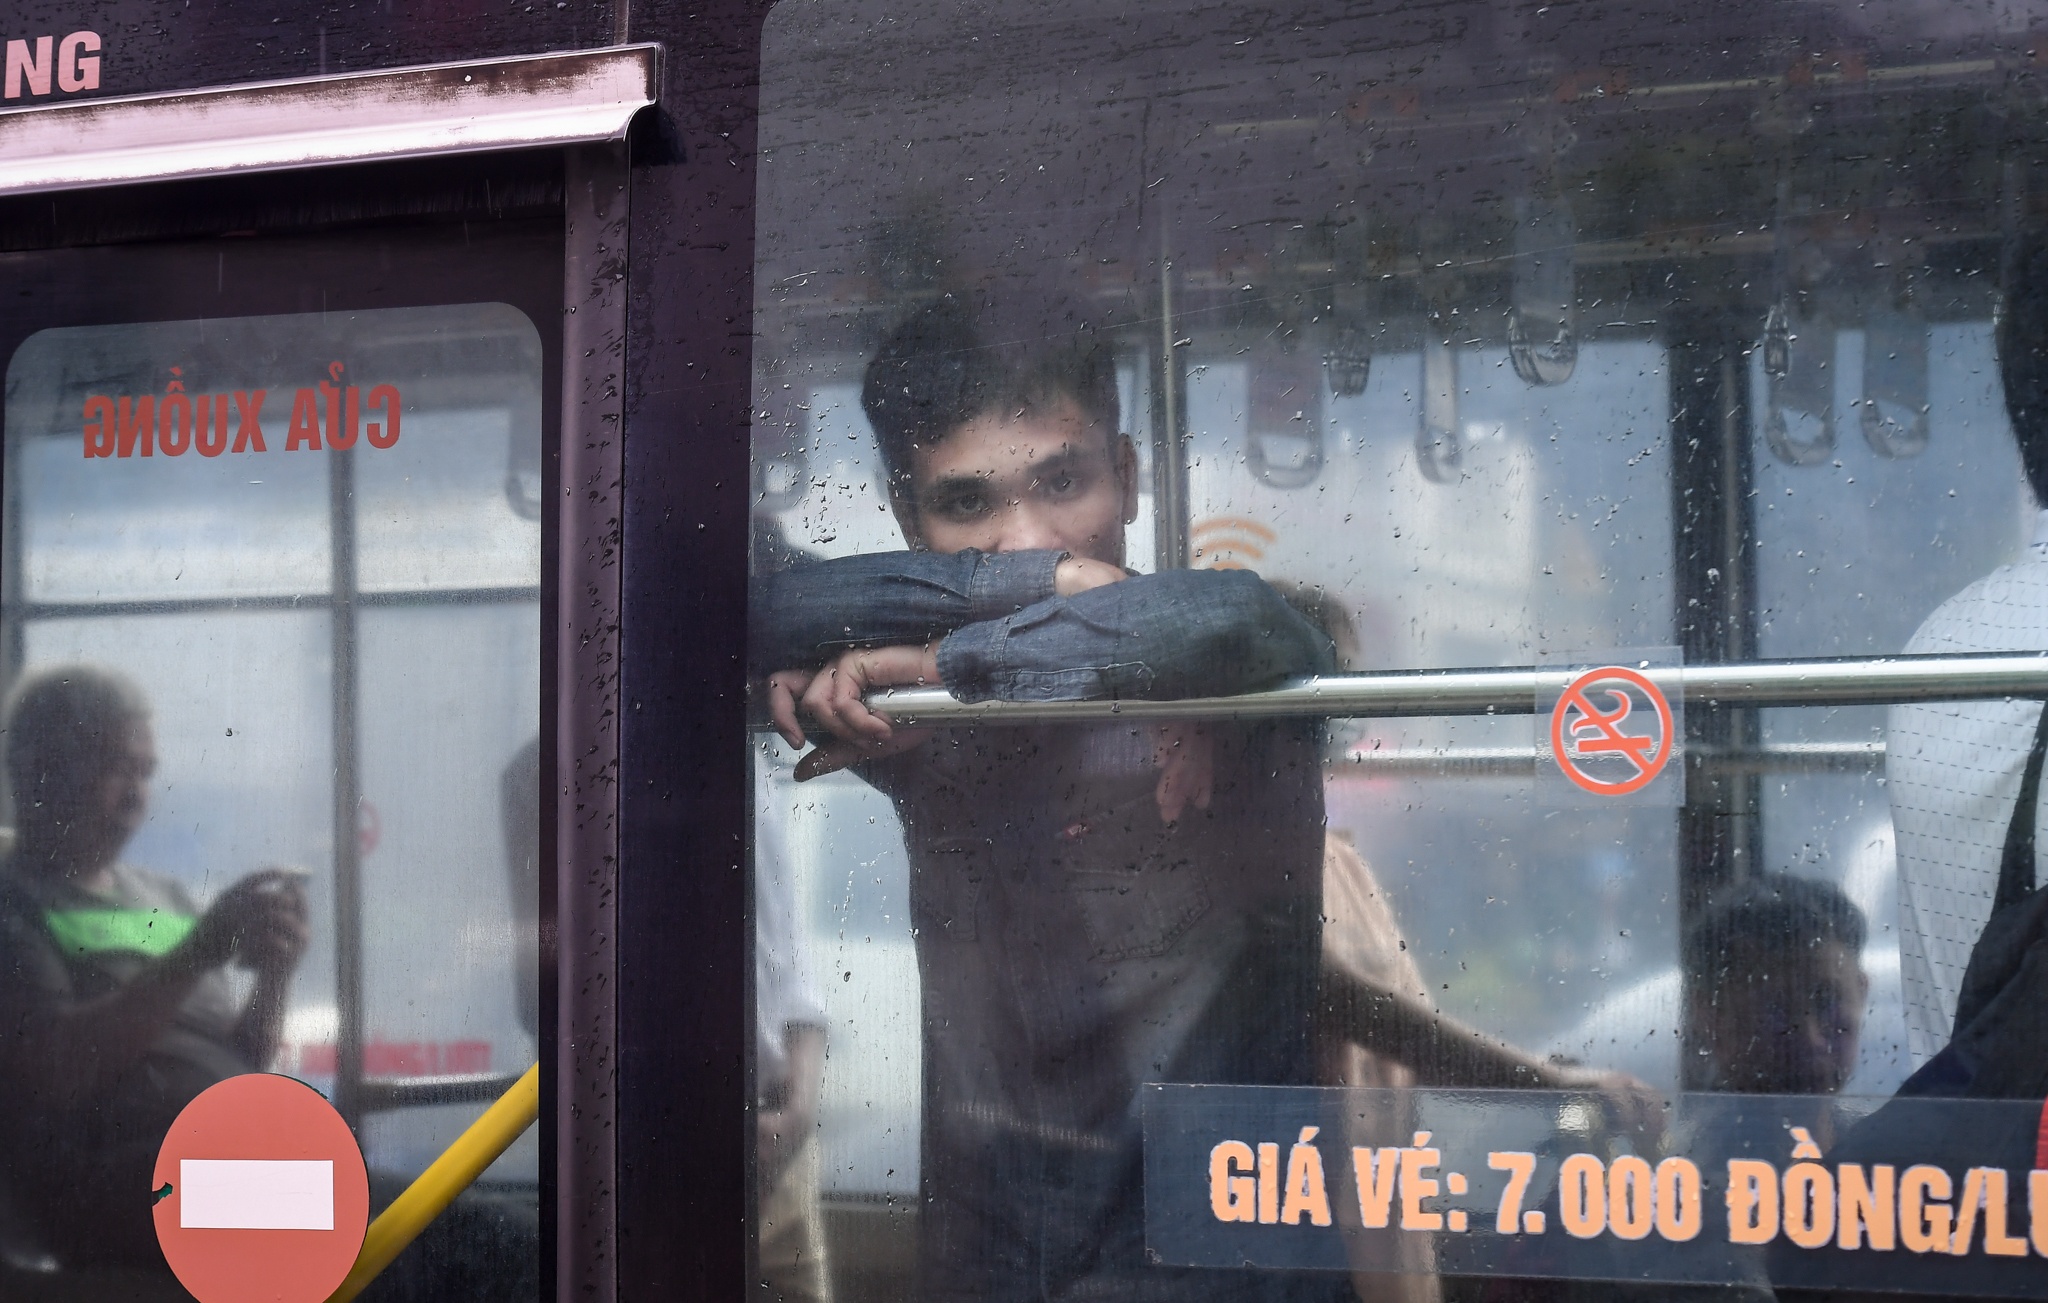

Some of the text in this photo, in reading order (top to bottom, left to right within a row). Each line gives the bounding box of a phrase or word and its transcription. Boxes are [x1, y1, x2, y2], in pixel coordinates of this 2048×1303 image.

[4, 30, 102, 99] NG
[1208, 1125, 1332, 1228] GIÁ
[1352, 1130, 1469, 1232] VÉ:
